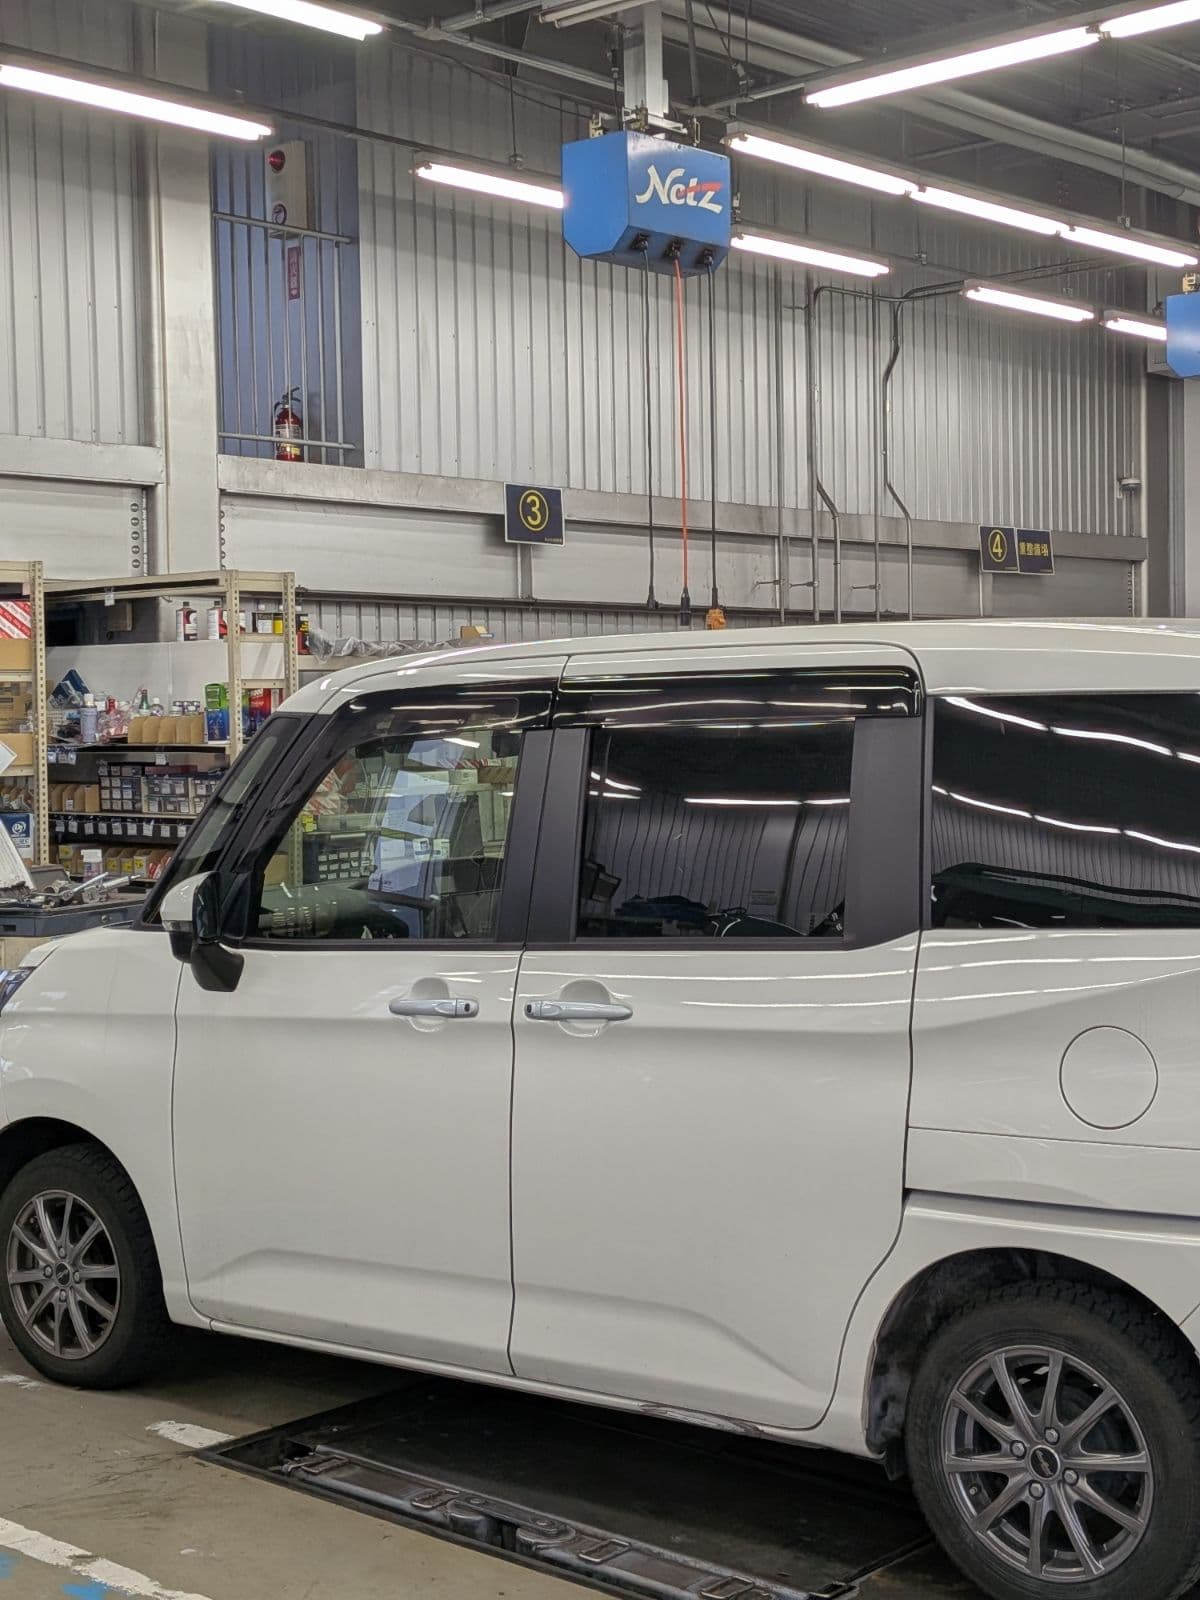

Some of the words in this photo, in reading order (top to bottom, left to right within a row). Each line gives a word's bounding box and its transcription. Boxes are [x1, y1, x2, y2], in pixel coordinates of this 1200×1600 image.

[635, 165, 723, 214] Netz
[526, 495, 542, 526] 3
[992, 533, 1003, 558] 4
